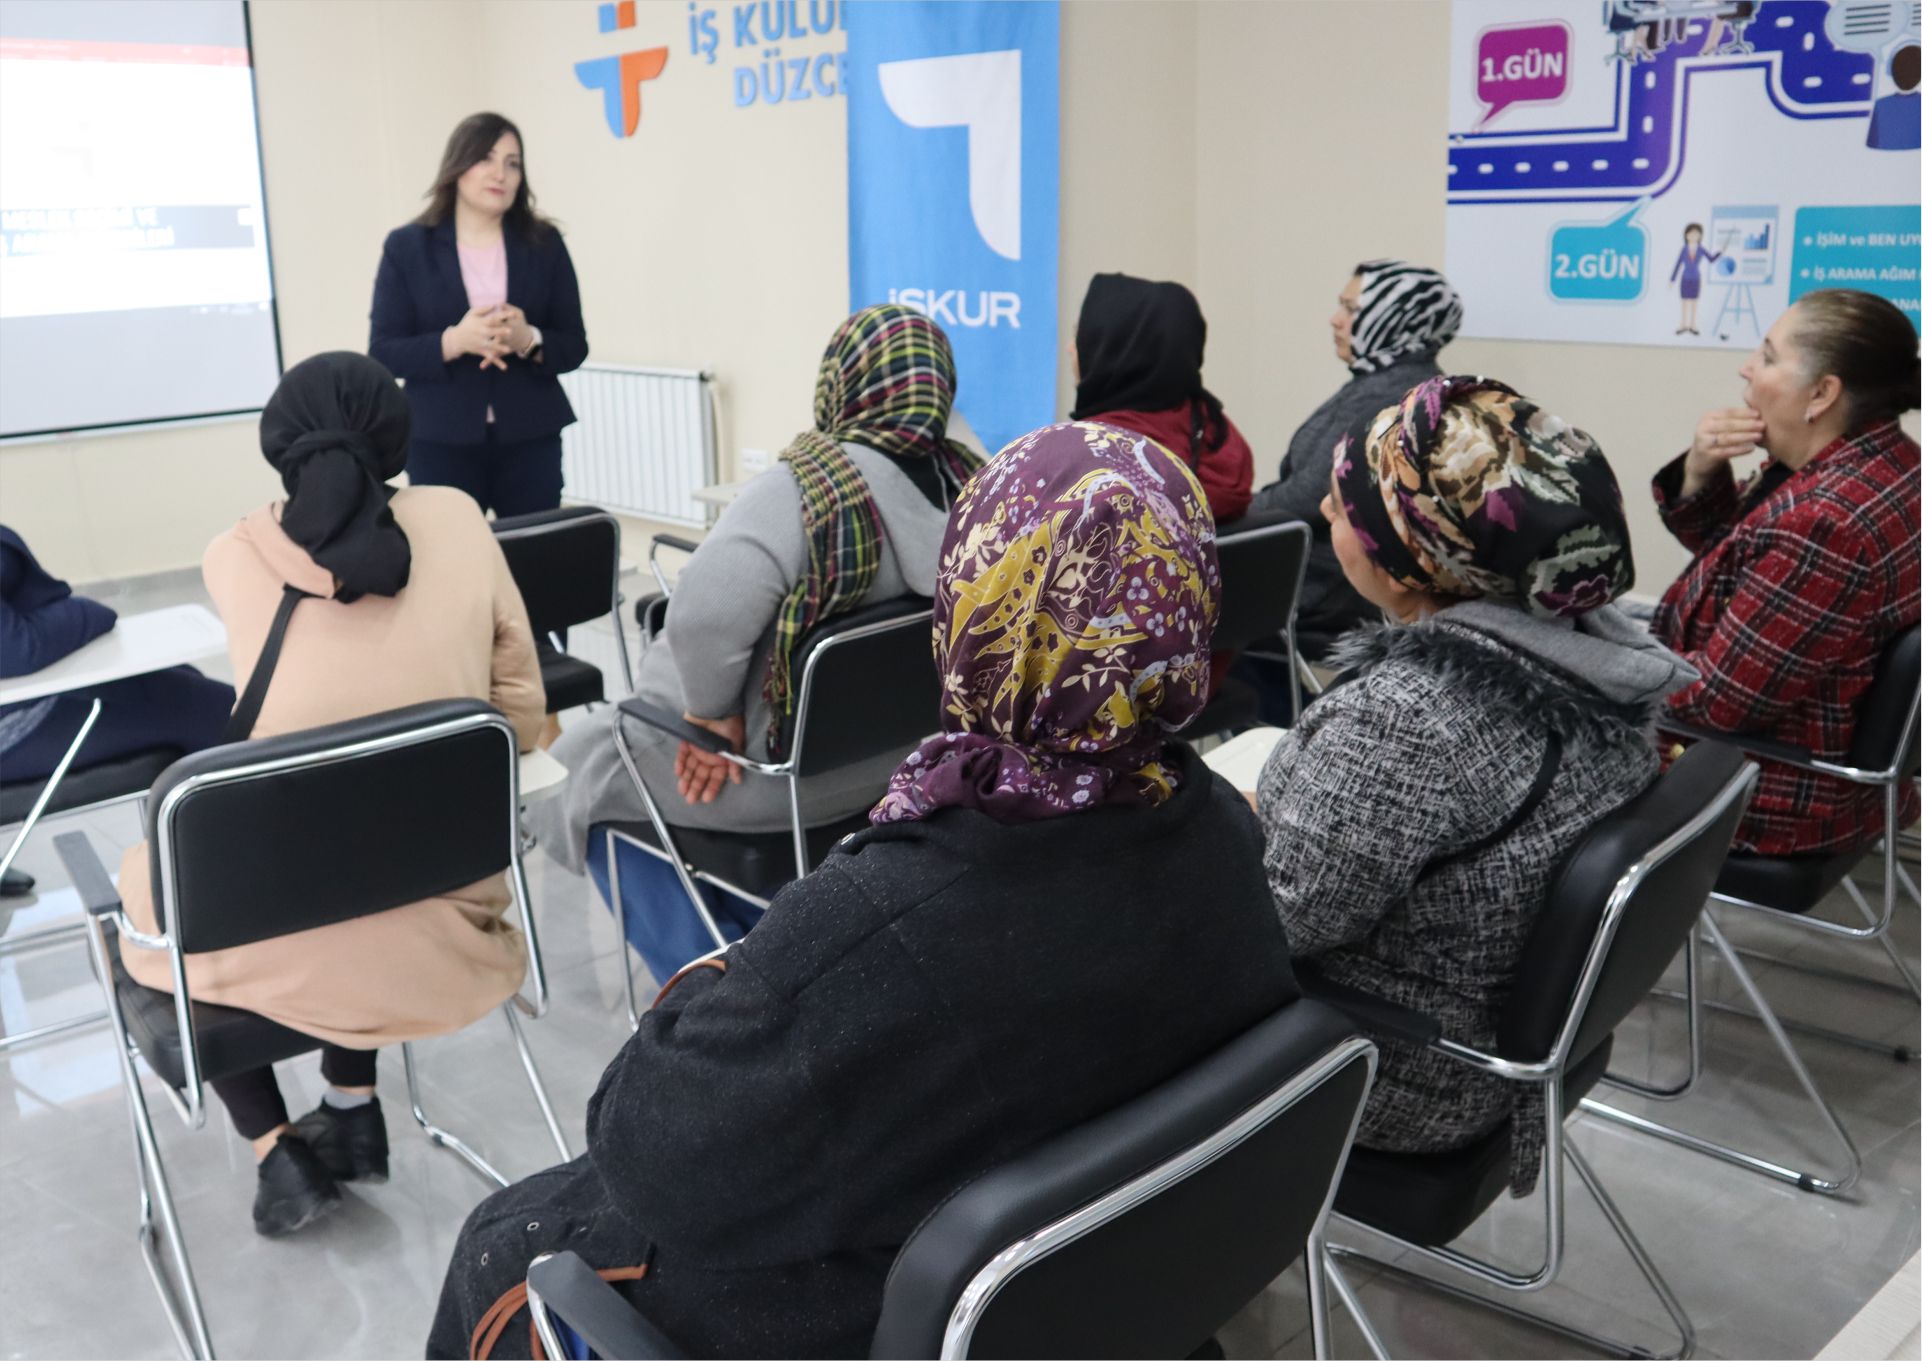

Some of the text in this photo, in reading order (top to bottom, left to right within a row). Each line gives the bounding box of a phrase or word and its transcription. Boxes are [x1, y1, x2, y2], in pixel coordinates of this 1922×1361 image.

[688, 1, 720, 65] İŞ
[1481, 48, 1564, 82] 1.GÜN
[1868, 233, 1897, 246] BEN
[1554, 248, 1640, 279] 2.GÜN
[1828, 267, 1877, 280] ARAMA
